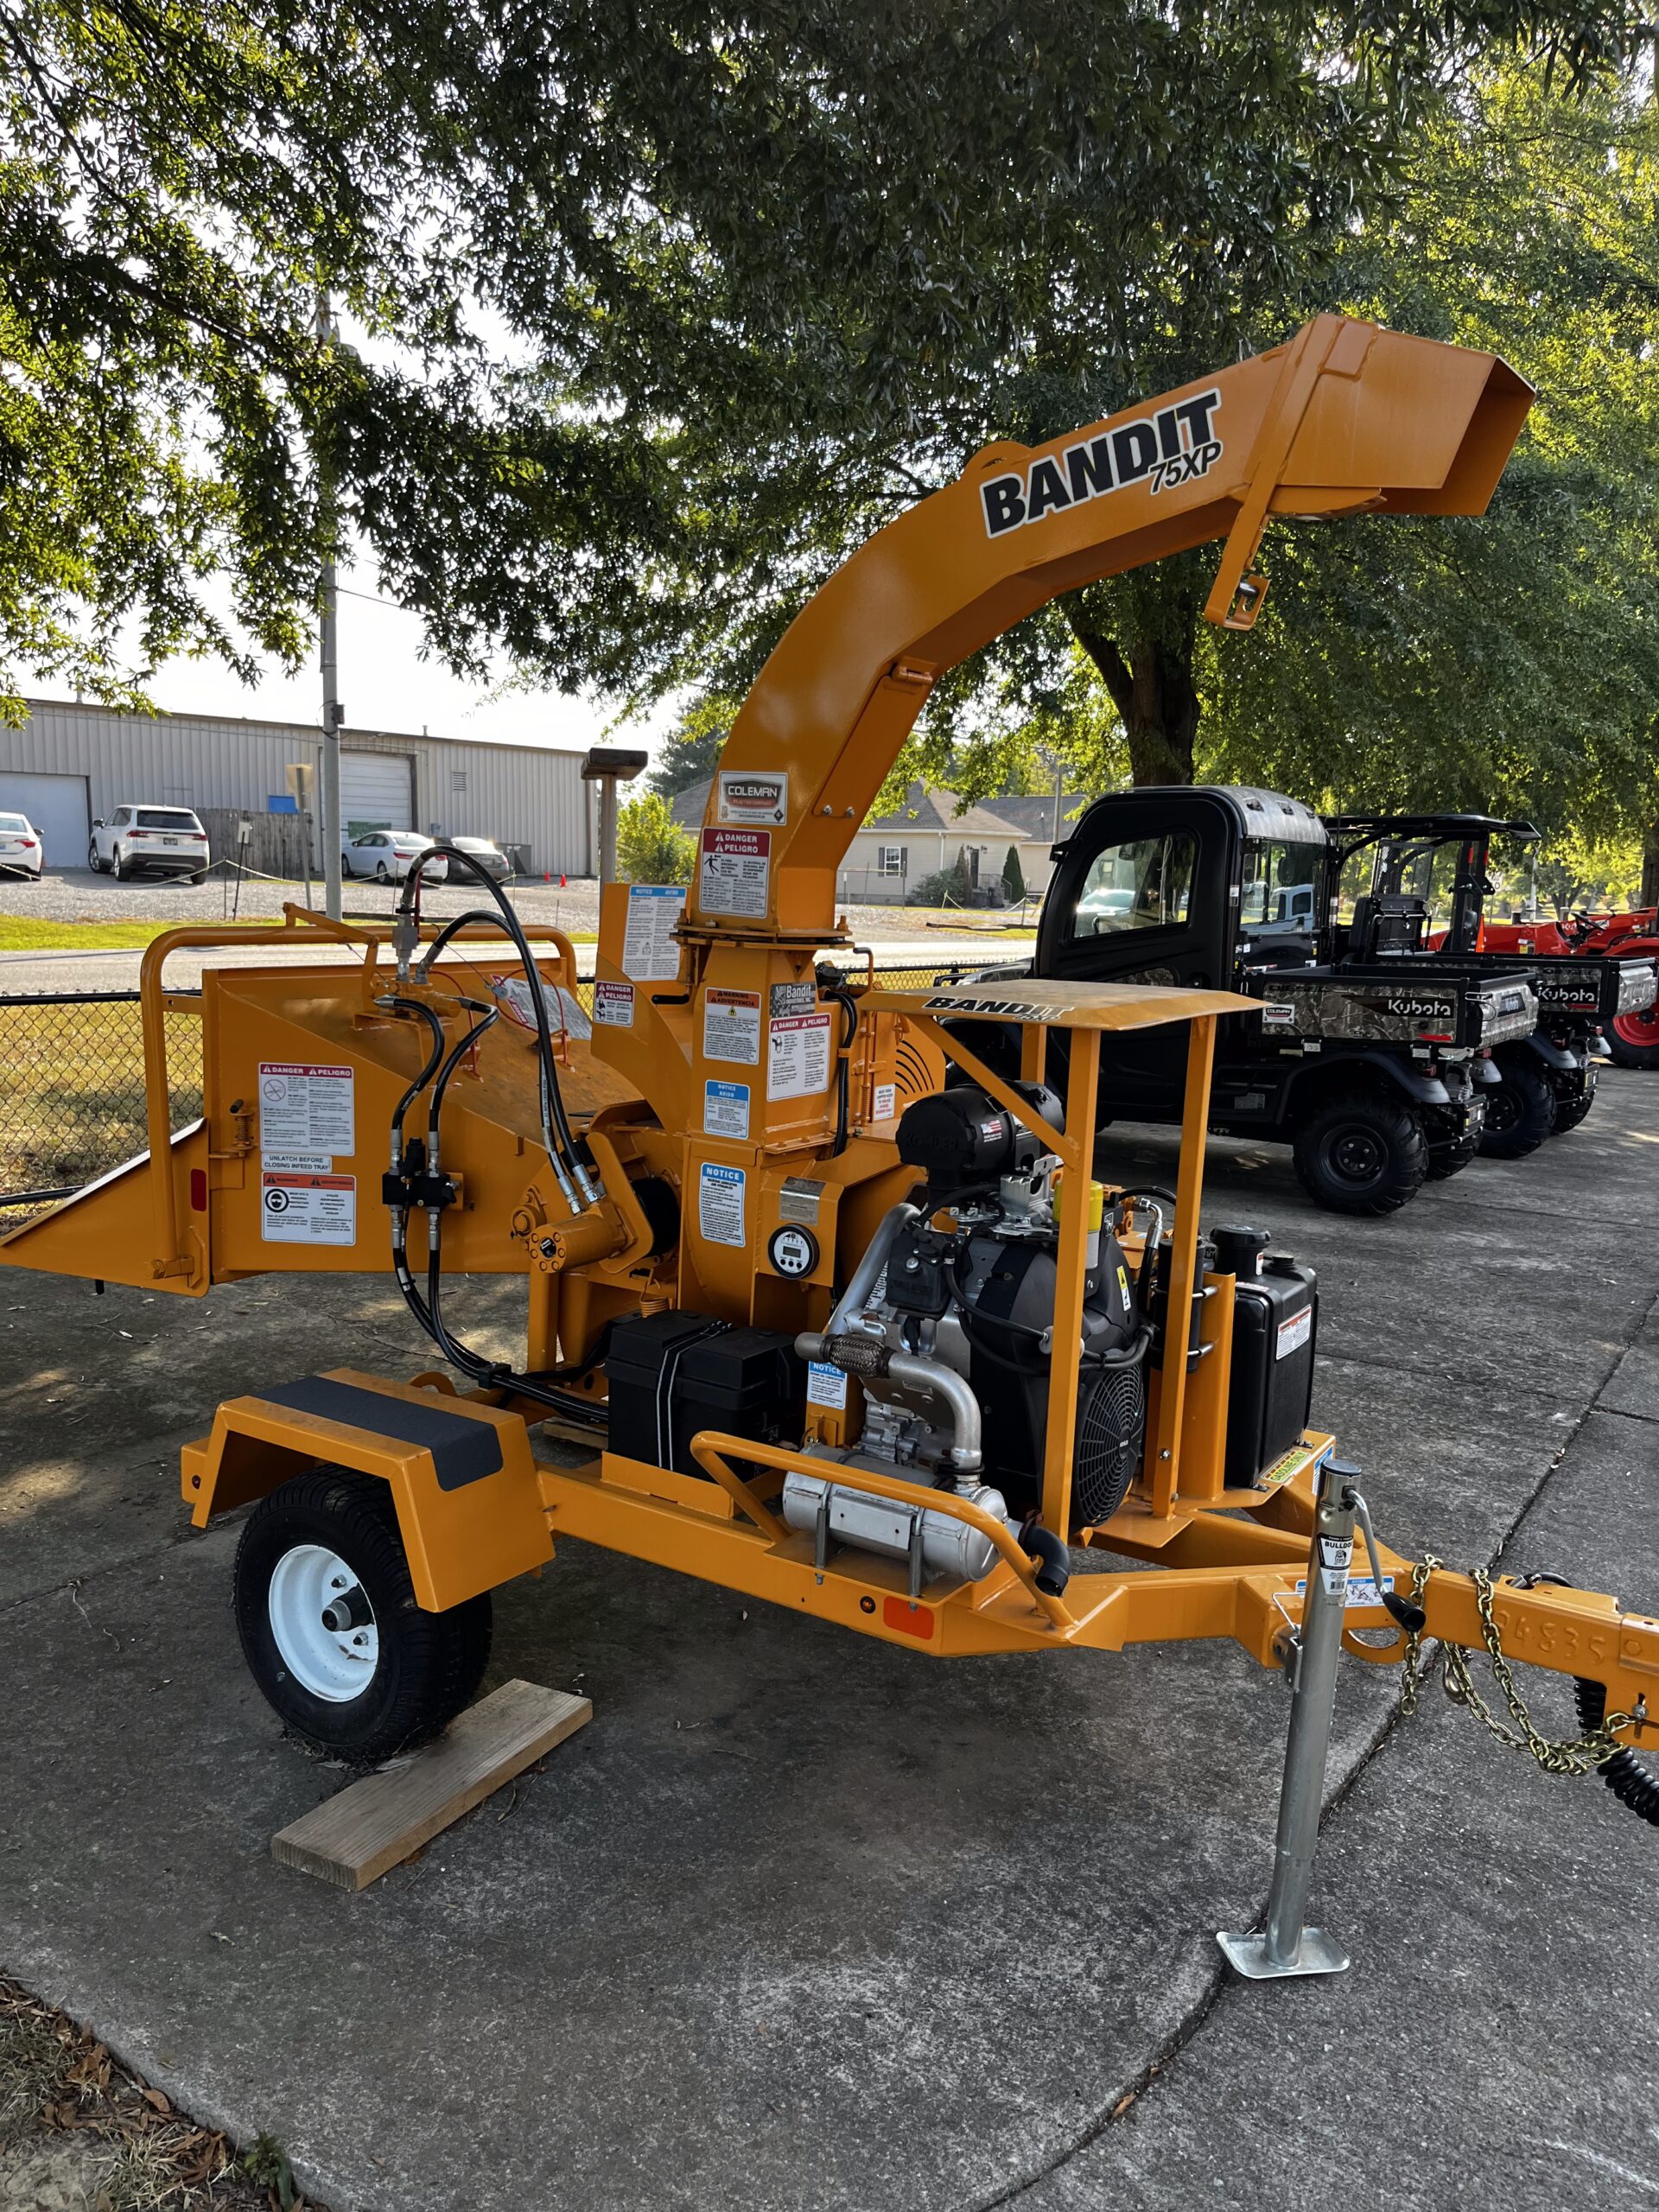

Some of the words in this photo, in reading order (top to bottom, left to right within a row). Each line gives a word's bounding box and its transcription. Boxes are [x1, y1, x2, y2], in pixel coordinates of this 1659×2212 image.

[982, 390, 1219, 537] BANDIT
[1150, 442, 1221, 494] 75XP
[728, 785, 778, 798] COLEMAN
[724, 833, 758, 843] DANGER
[724, 843, 759, 854] PELIGRO
[606, 984, 632, 993] DANGER
[786, 984, 811, 999] Bandit
[1538, 988, 1595, 1001] Kubota
[605, 992, 632, 1001] PELIGRO
[922, 996, 1075, 1017] BANDIT
[1388, 999, 1452, 1016] Kubota
[779, 1020, 799, 1029] DANGER
[807, 1017, 828, 1026] PELIGRO
[706, 1166, 740, 1180] NOTICE
[813, 1363, 842, 1375] NOTICE
[1270, 1460, 1296, 1481] GASOLINE
[1325, 1541, 1352, 1549] BULLDO
